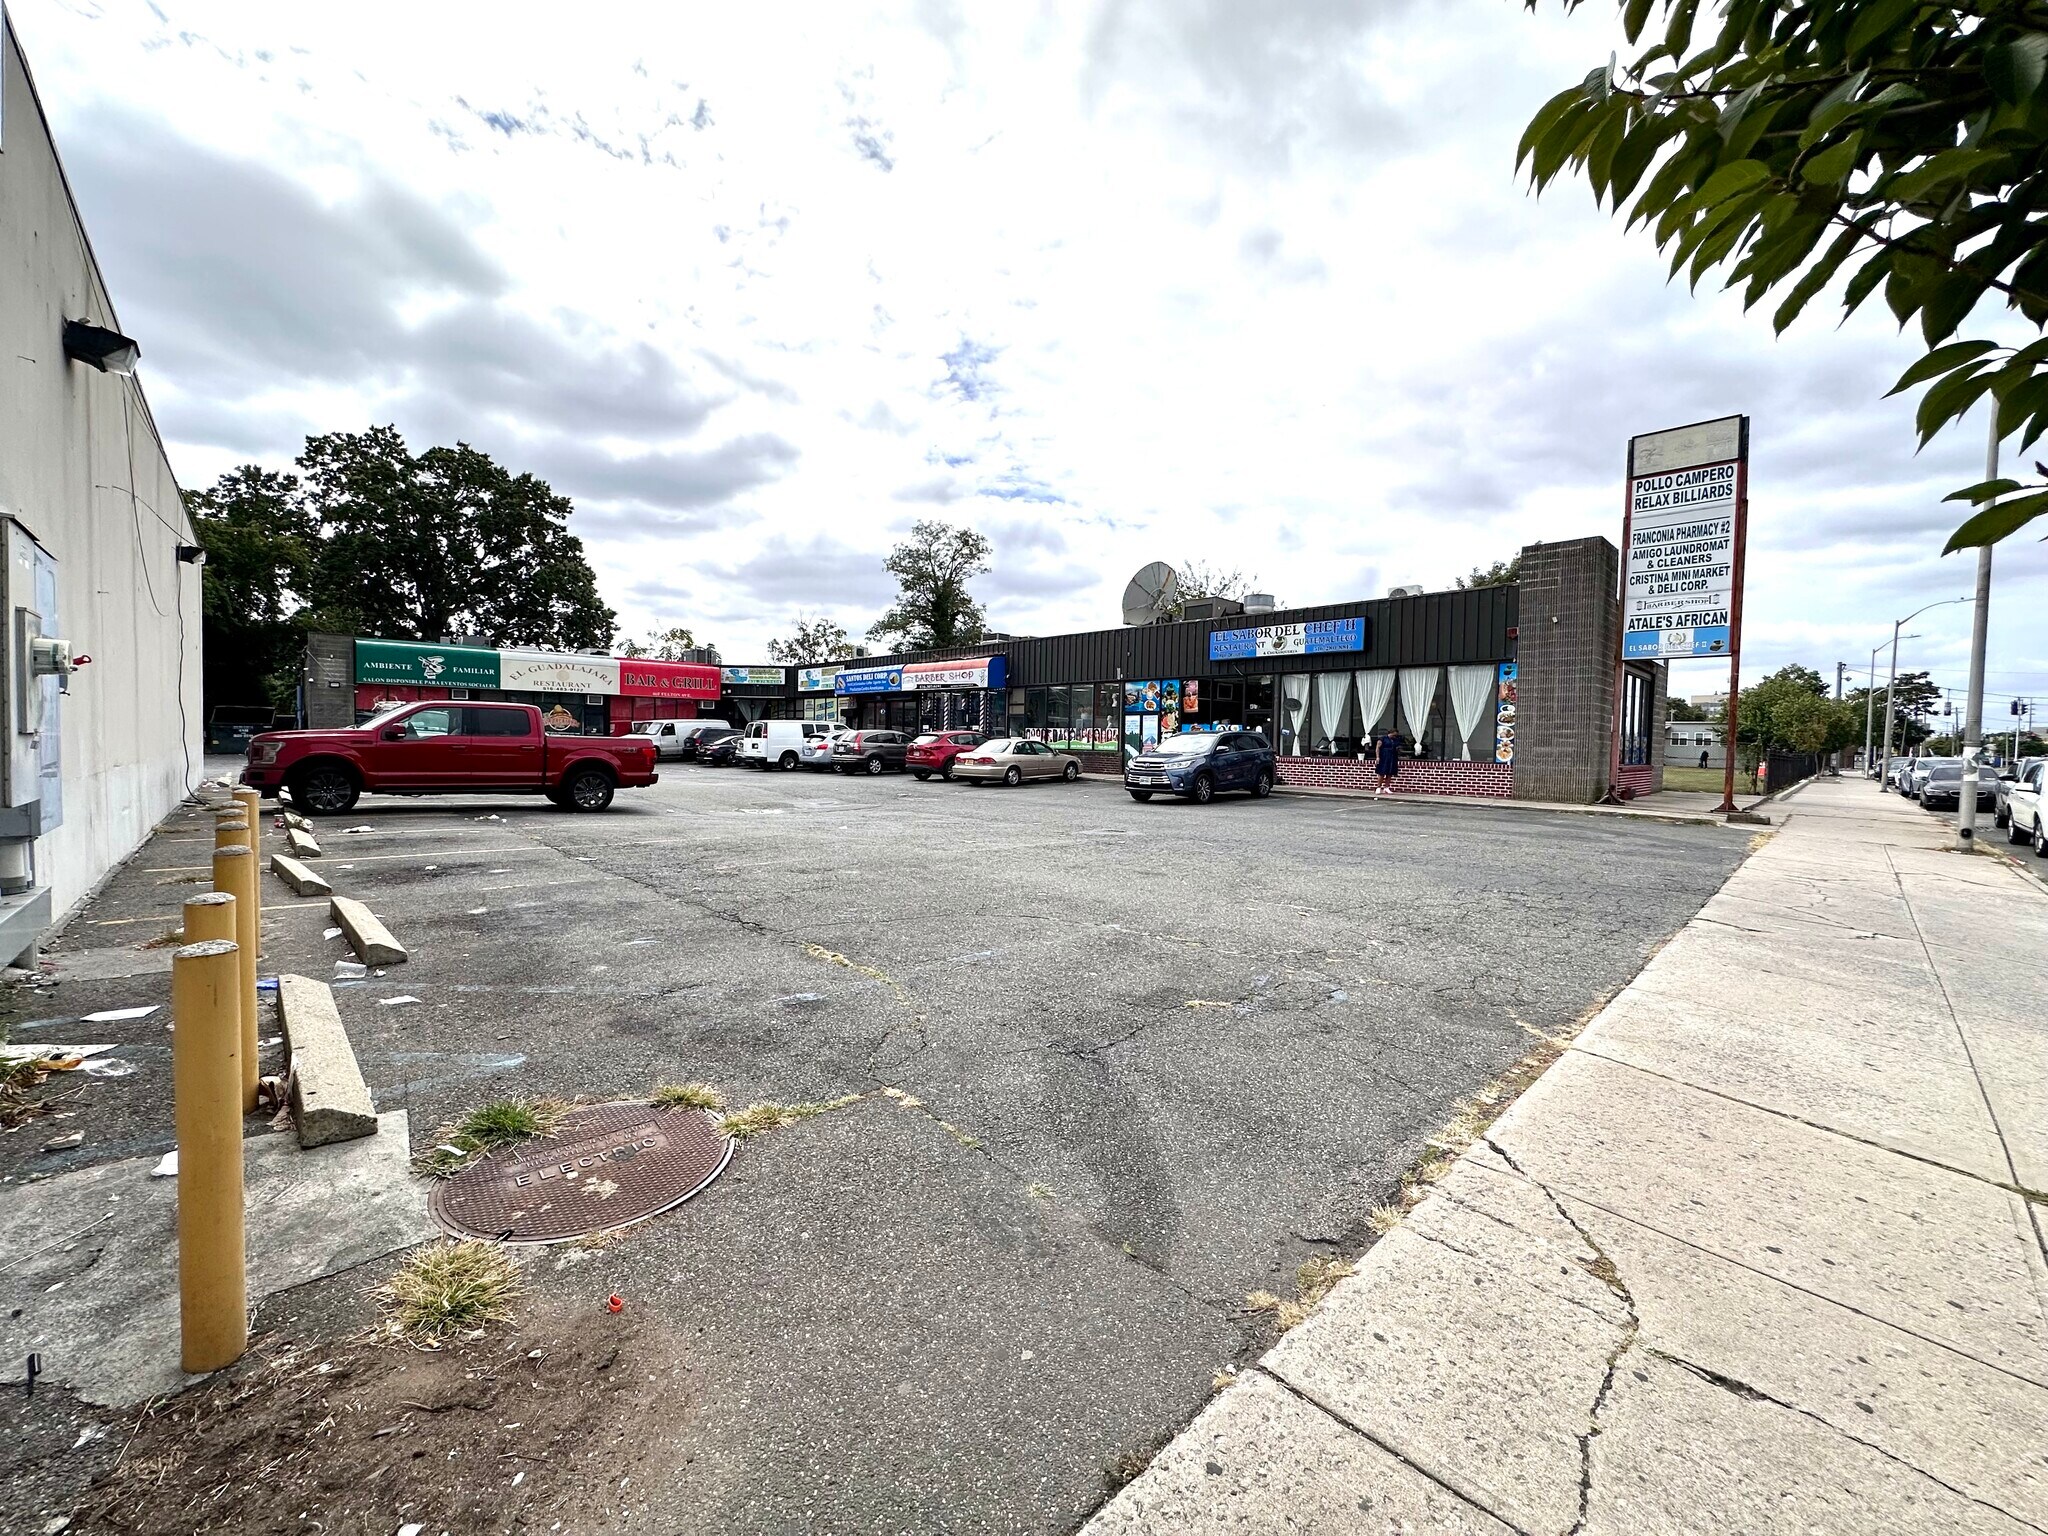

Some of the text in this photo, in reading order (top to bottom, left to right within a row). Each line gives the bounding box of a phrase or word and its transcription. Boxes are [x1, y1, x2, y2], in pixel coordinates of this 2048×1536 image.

[1636, 465, 1734, 494] POLLO CAMPERO
[1634, 482, 1733, 510] RELAX BILLIARDS
[1632, 520, 1731, 545] FRANCONIA PHARMACY #2
[1632, 539, 1730, 561] AMIGO LAUNDROMAT
[1647, 553, 1712, 569] & CLEANERS
[1629, 565, 1730, 586] CRISTINA MINI MARKET
[1648, 579, 1708, 595] & DELI CORP.
[1214, 618, 1356, 642] EL SABOR DEL CHEF II
[1628, 611, 1728, 631] ATALE'S AFRICAN
[1214, 640, 1267, 653] RESTAURANT
[1293, 635, 1357, 647] GUATEMALTECO
[1638, 643, 1663, 651] SABOR
[363, 662, 495, 675] AMBIENTE FAMILIAR
[509, 663, 613, 686] EL GUADALAJARA
[845, 672, 888, 682] SANTOS DELI CORP.
[914, 671, 974, 684] BARBER SHOP
[533, 680, 592, 689] RESTAURANT
[624, 672, 717, 690] BAR & GRILL
[514, 1137, 657, 1188] ELECTRIC
